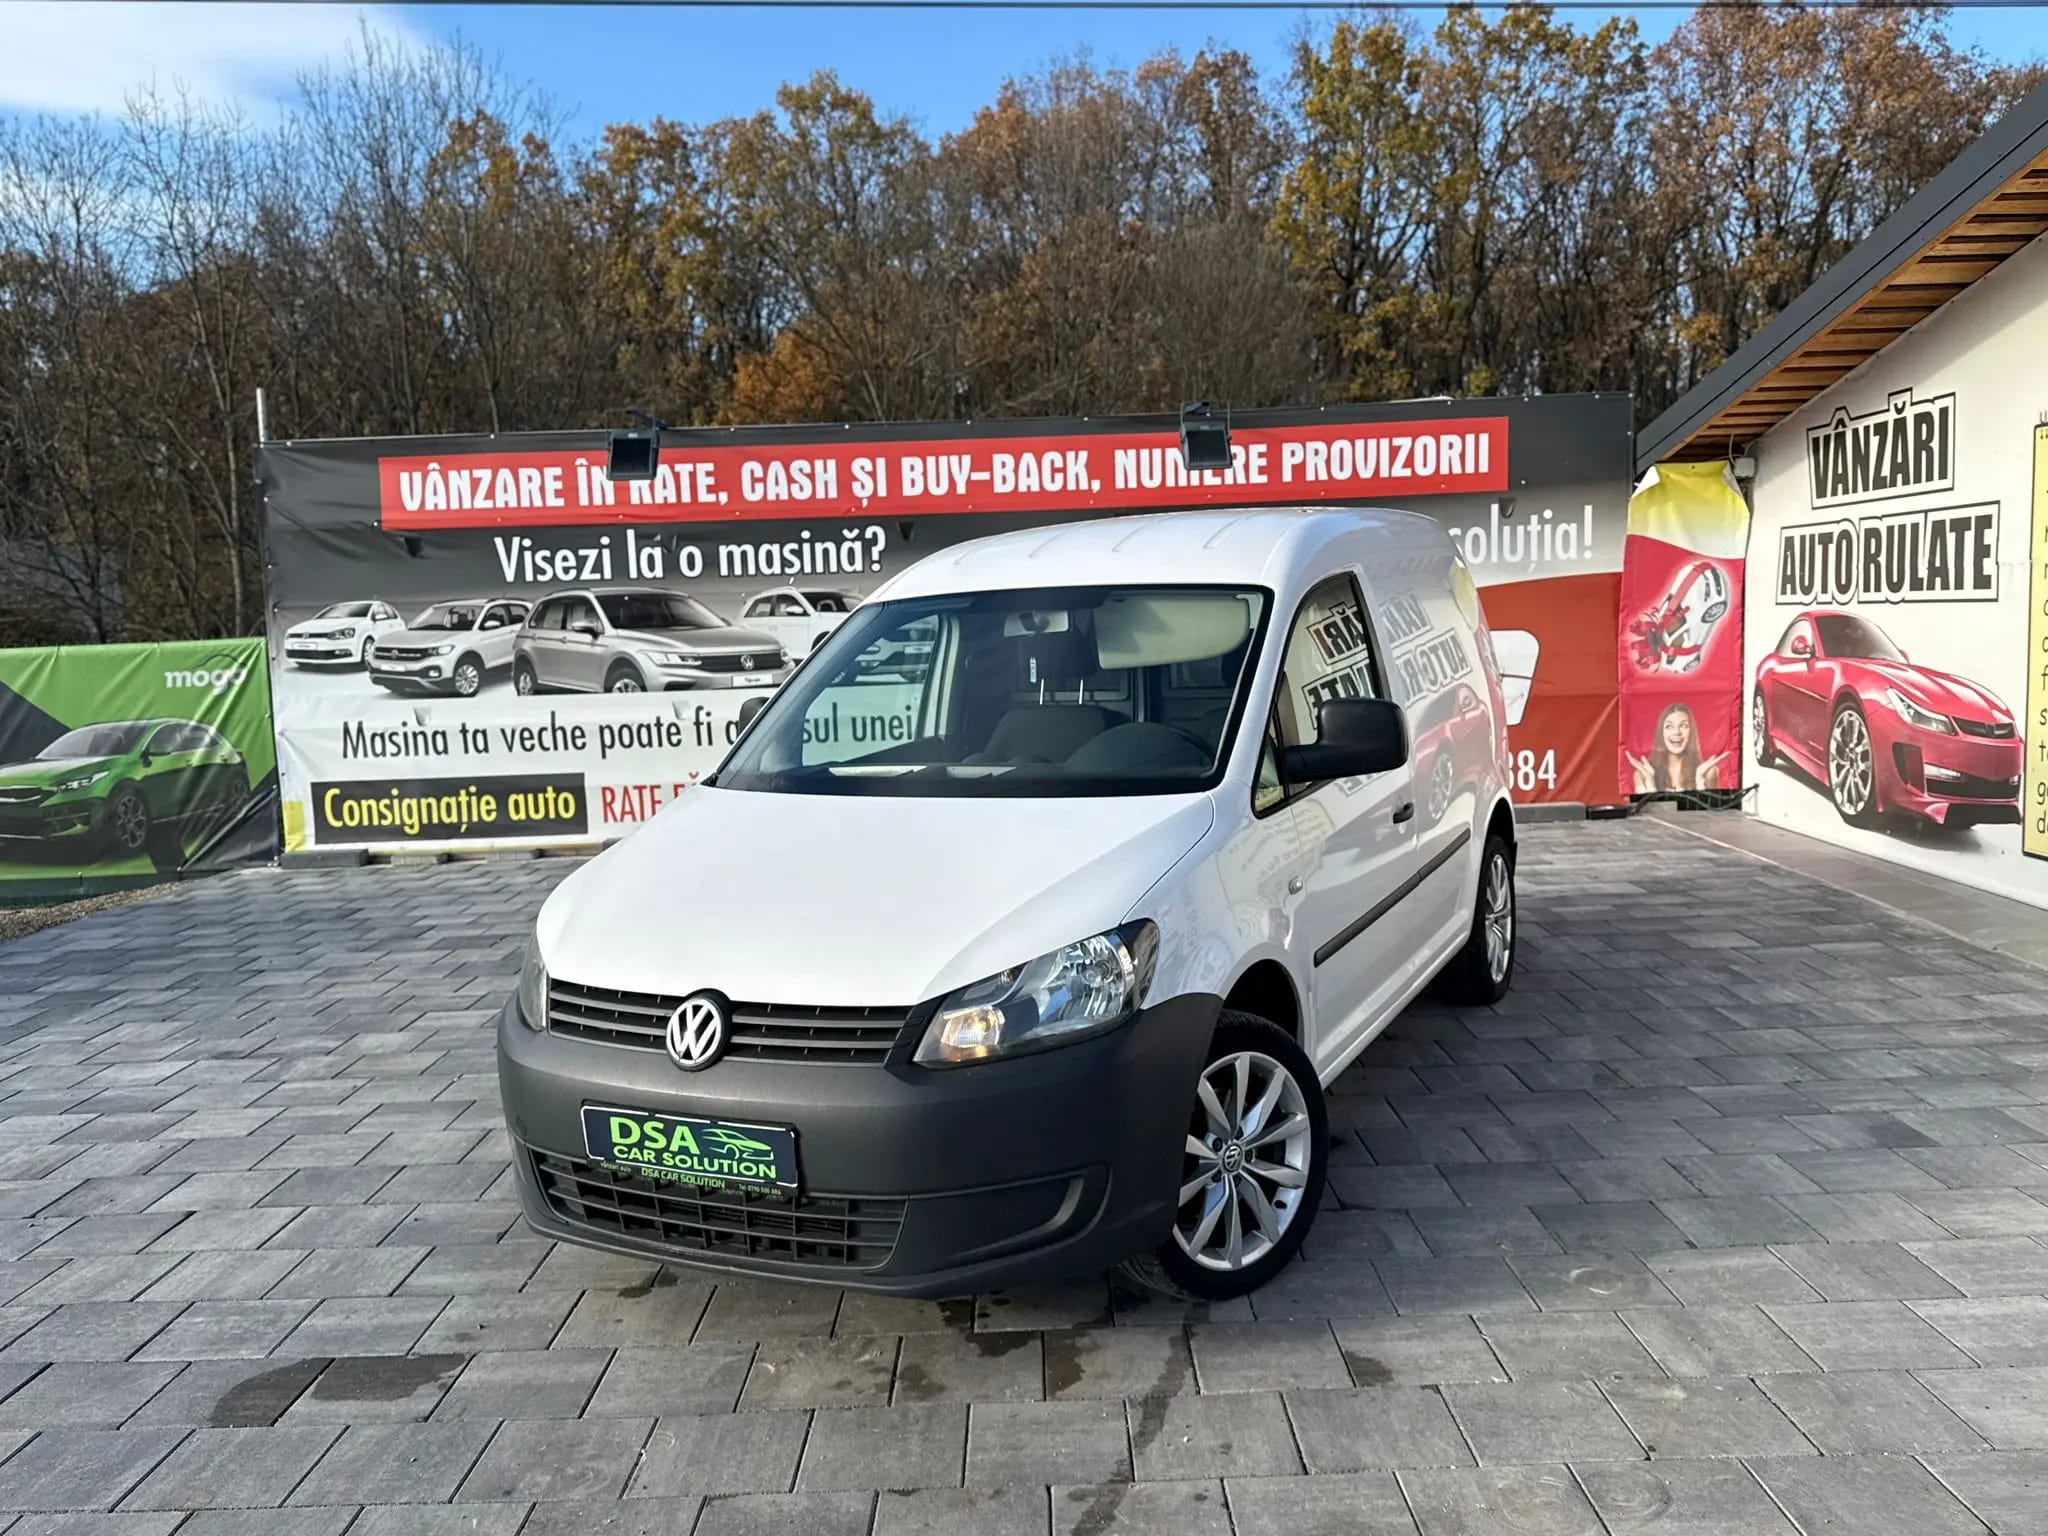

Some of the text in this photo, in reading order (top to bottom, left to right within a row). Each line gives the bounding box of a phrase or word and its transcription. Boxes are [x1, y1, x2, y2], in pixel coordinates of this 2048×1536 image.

[400, 462, 565, 513] VÂNZARE
[741, 459, 838, 502] CASH
[851, 457, 887, 508] ȘI
[901, 450, 1101, 497] BUY-BACK,
[1281, 432, 1490, 483] PROVIZORII
[1812, 400, 1949, 500] VÂNZĂRI
[493, 535, 613, 583] Visezi
[624, 528, 664, 580] la
[679, 544, 703, 578] o
[718, 525, 887, 585] mașină?
[1780, 513, 1993, 596] AUTO RULATE
[459, 722, 489, 754] ta
[500, 710, 587, 752] veche
[599, 716, 682, 760] poate
[693, 705, 713, 747] fi
[852, 704, 913, 742] unei
[324, 784, 497, 835] Consignație
[508, 786, 576, 821] auto
[609, 1116, 701, 1155] DSA
[613, 1145, 656, 1167] CAR
[662, 1151, 777, 1179] SOLUTION
[641, 1167, 660, 1179] DSA
[661, 1171, 680, 1182] CAR
[680, 1174, 726, 1189] SOLUTION
